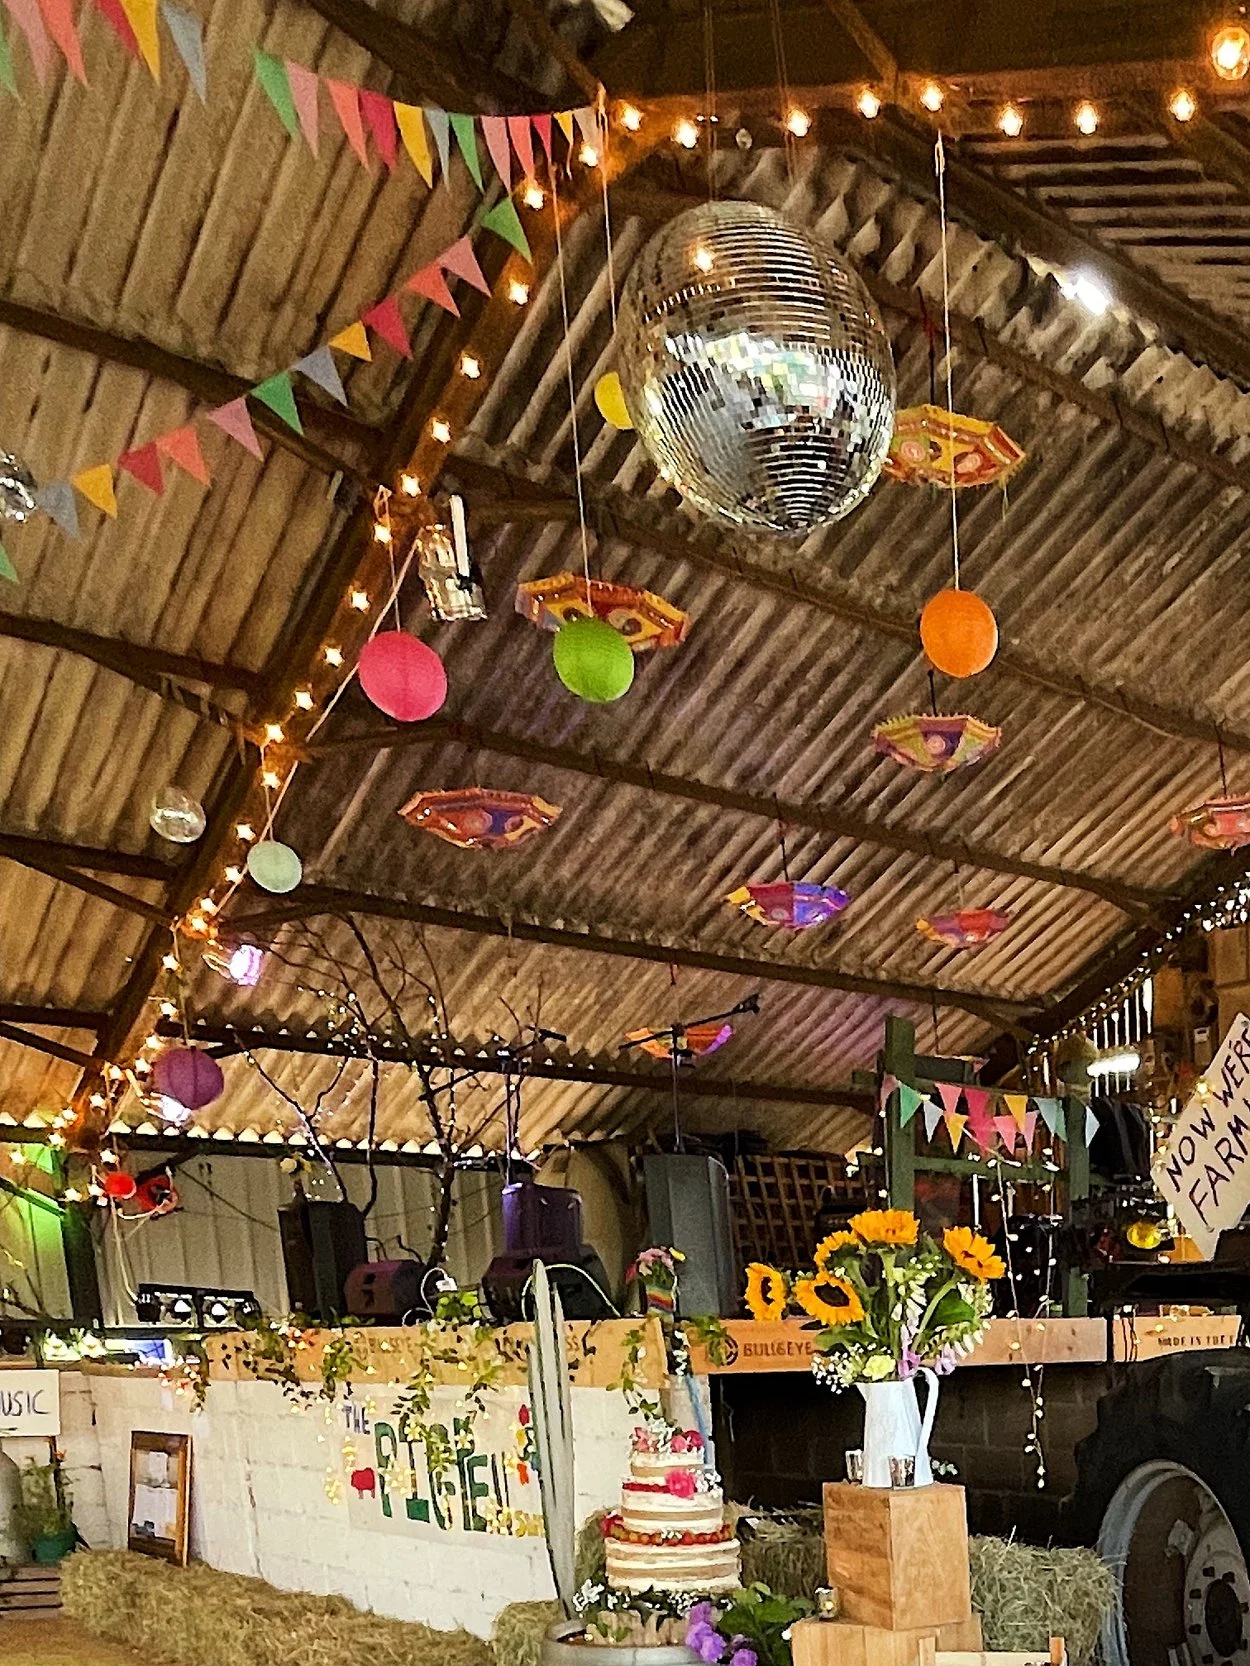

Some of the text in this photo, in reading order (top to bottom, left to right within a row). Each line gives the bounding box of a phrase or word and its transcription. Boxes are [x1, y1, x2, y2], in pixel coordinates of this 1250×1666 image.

[1166, 1107, 1216, 1193] NOW
[0, 1389, 49, 1417] USIC
[344, 1405, 371, 1435] THE
